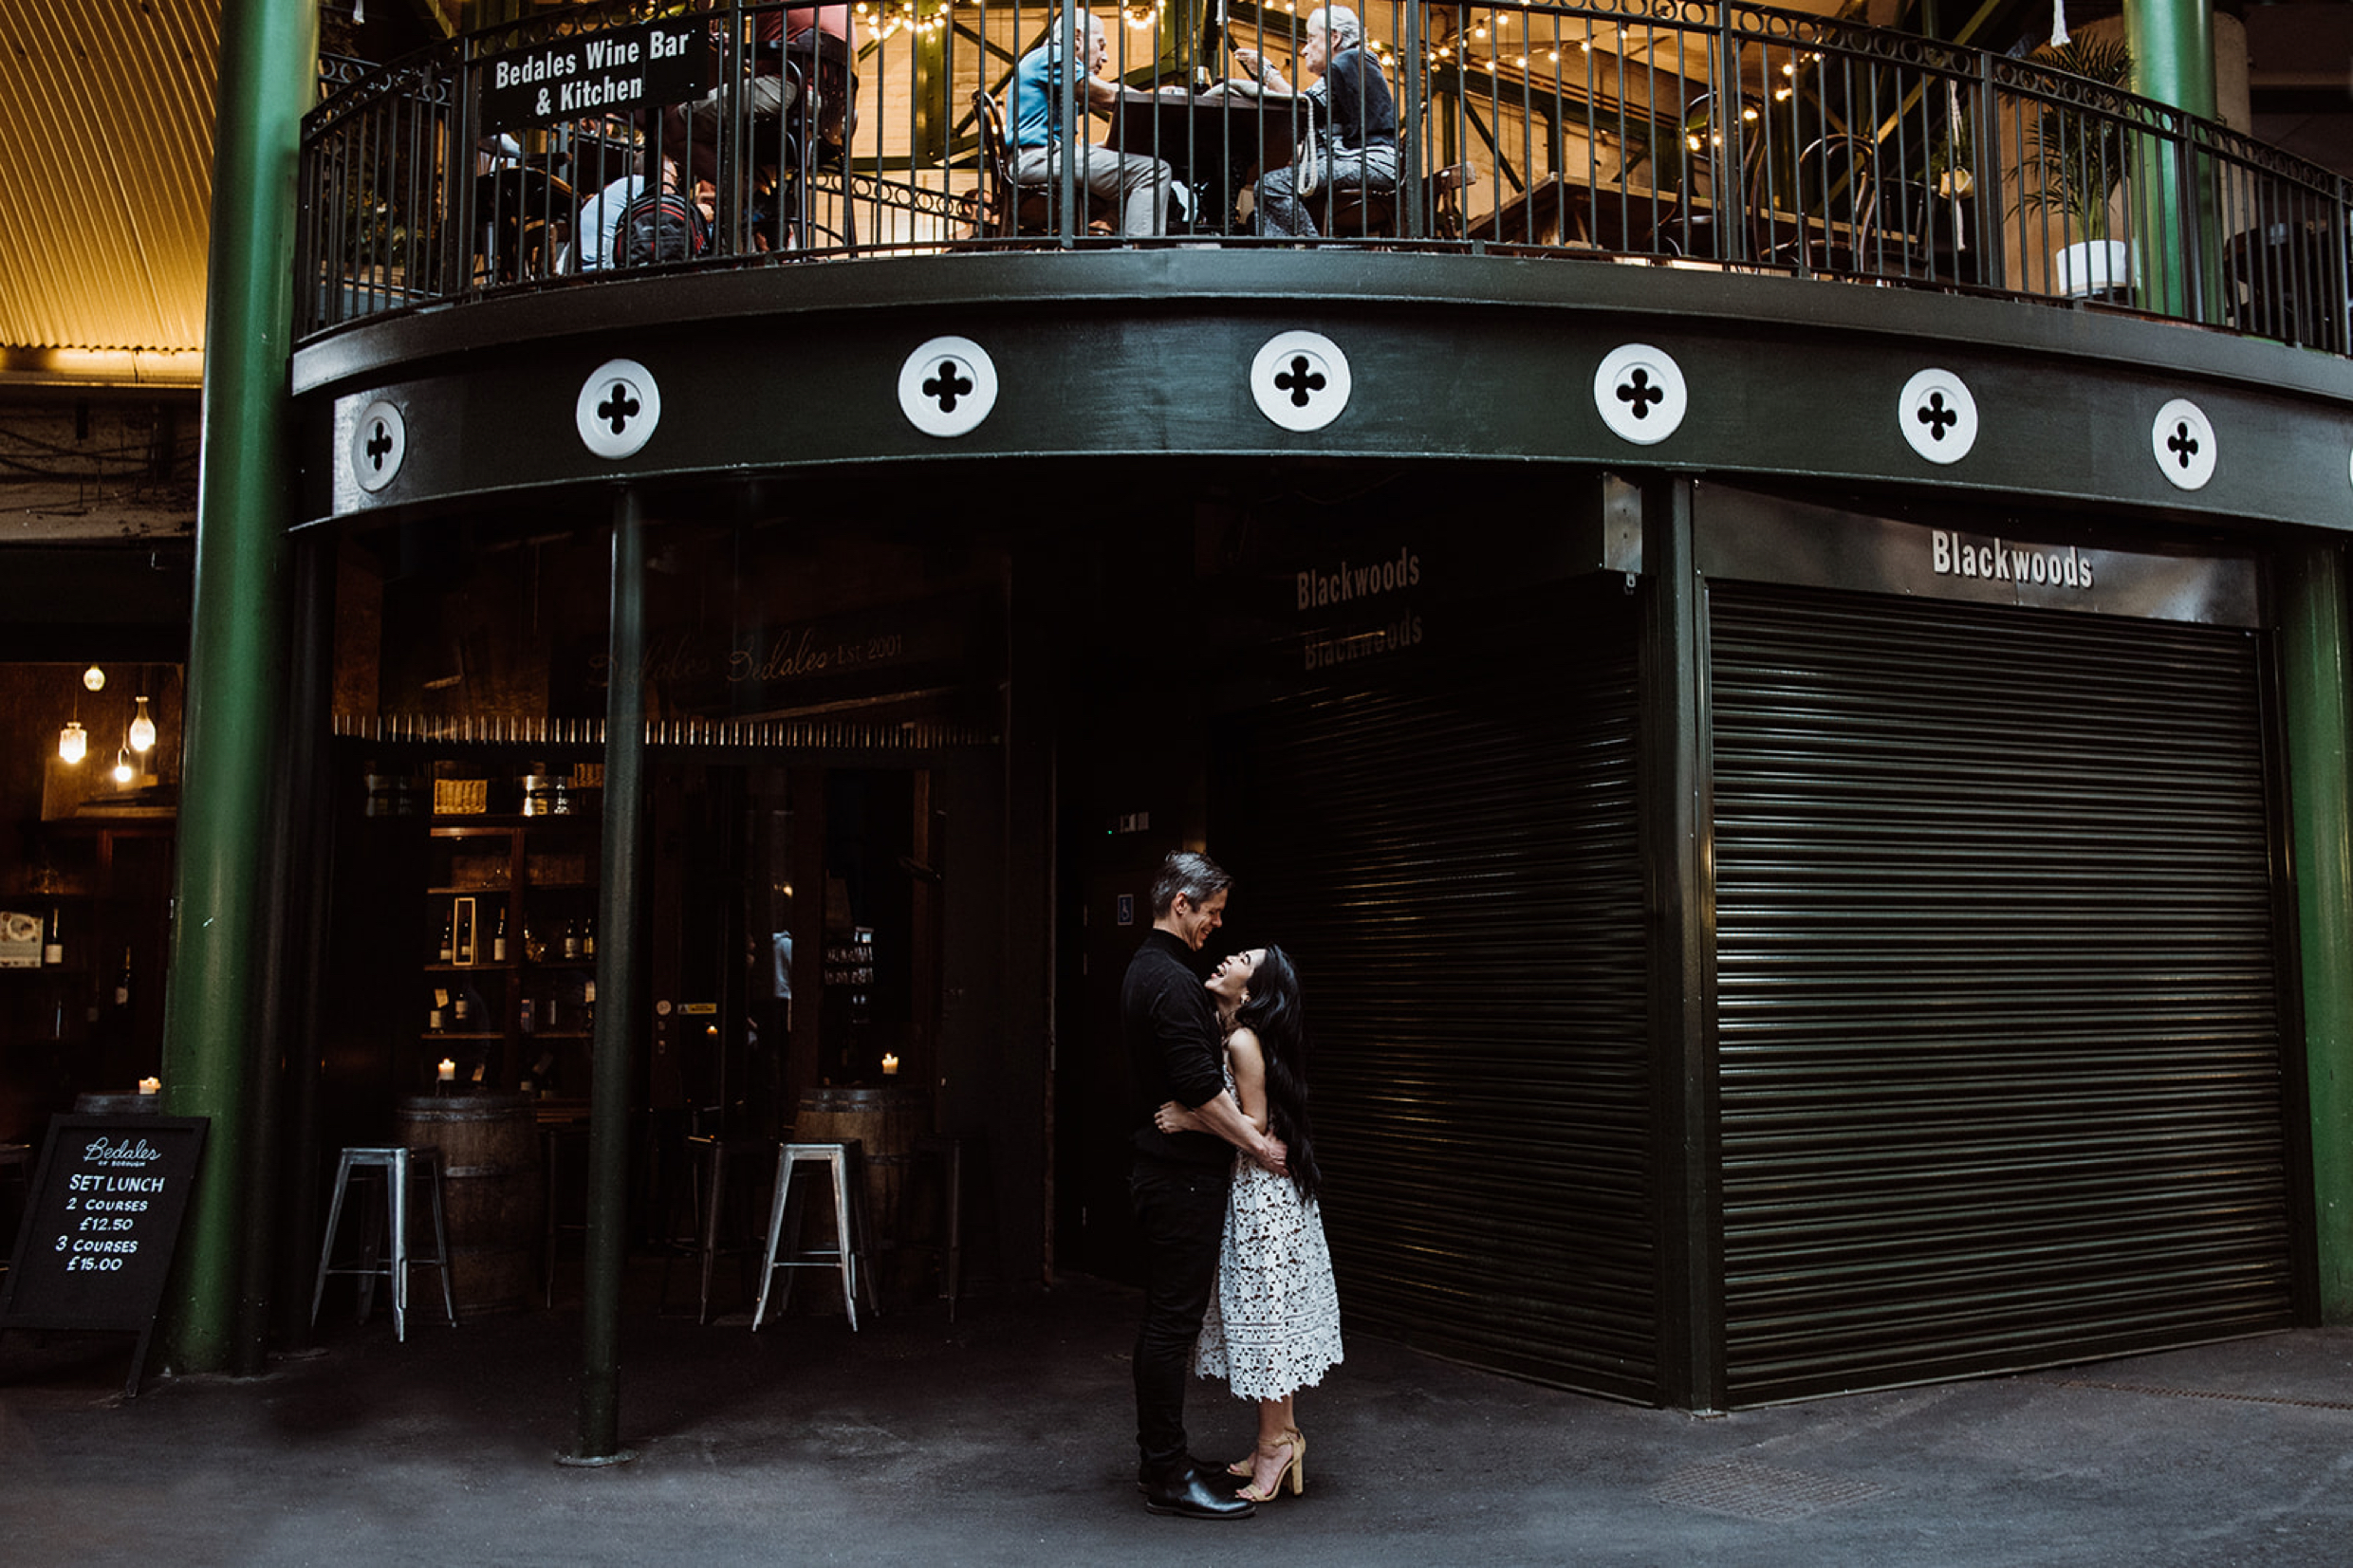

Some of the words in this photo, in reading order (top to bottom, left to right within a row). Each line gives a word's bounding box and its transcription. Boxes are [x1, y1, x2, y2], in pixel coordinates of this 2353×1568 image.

[495, 50, 578, 90] Bedales
[584, 38, 640, 71] Wine
[649, 29, 690, 60] Bar
[534, 86, 552, 117] &
[560, 75, 642, 113] Kitchen
[1932, 529, 2094, 588] Blackwoods
[1296, 544, 1421, 612] Blackwoods
[868, 634, 902, 660] 2001
[83, 1135, 162, 1162] Bedales
[69, 1173, 106, 1191] SET
[106, 1175, 166, 1192] LUNCH
[65, 1196, 78, 1210] 2
[84, 1198, 149, 1212] COURSES
[79, 1216, 134, 1231] £12.50
[55, 1234, 69, 1252] 3
[72, 1239, 139, 1253] COURSES
[66, 1255, 123, 1271] £15.00
